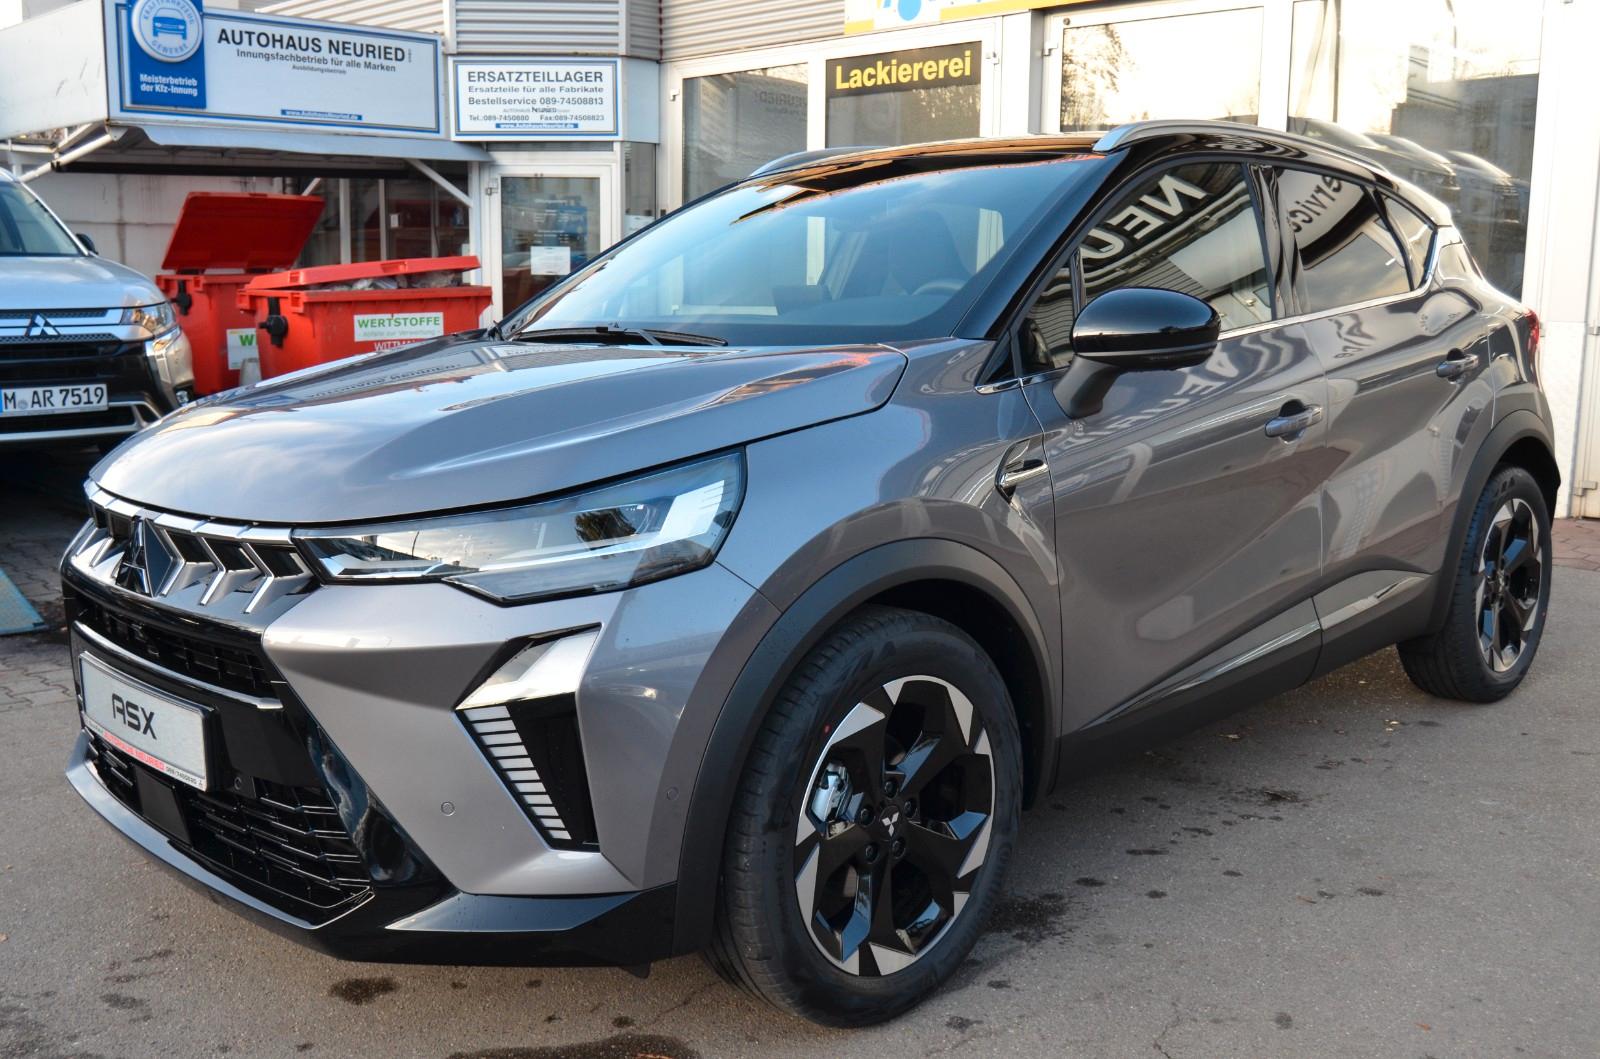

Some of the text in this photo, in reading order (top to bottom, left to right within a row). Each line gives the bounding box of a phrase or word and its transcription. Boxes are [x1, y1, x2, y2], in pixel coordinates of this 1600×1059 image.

[217, 28, 322, 54] AUTOHAUS
[328, 39, 405, 62] NEURIED
[236, 48, 396, 72] Innungsfachbetrieb für alle Marken
[467, 71, 603, 83] ERSATZTEILLAGER
[835, 50, 972, 90] Lackiererei
[140, 73, 198, 87] Meisterbetrieb
[140, 83, 198, 97] der Kfz-Innung
[468, 85, 604, 93] Ersatzteile für alle Fabrikate
[468, 97, 604, 105] Bestellservice 089-74508813
[357, 316, 441, 329] WERTSTOFFE
[3, 386, 105, 410] M AR 7519
[112, 693, 157, 740] ASX
